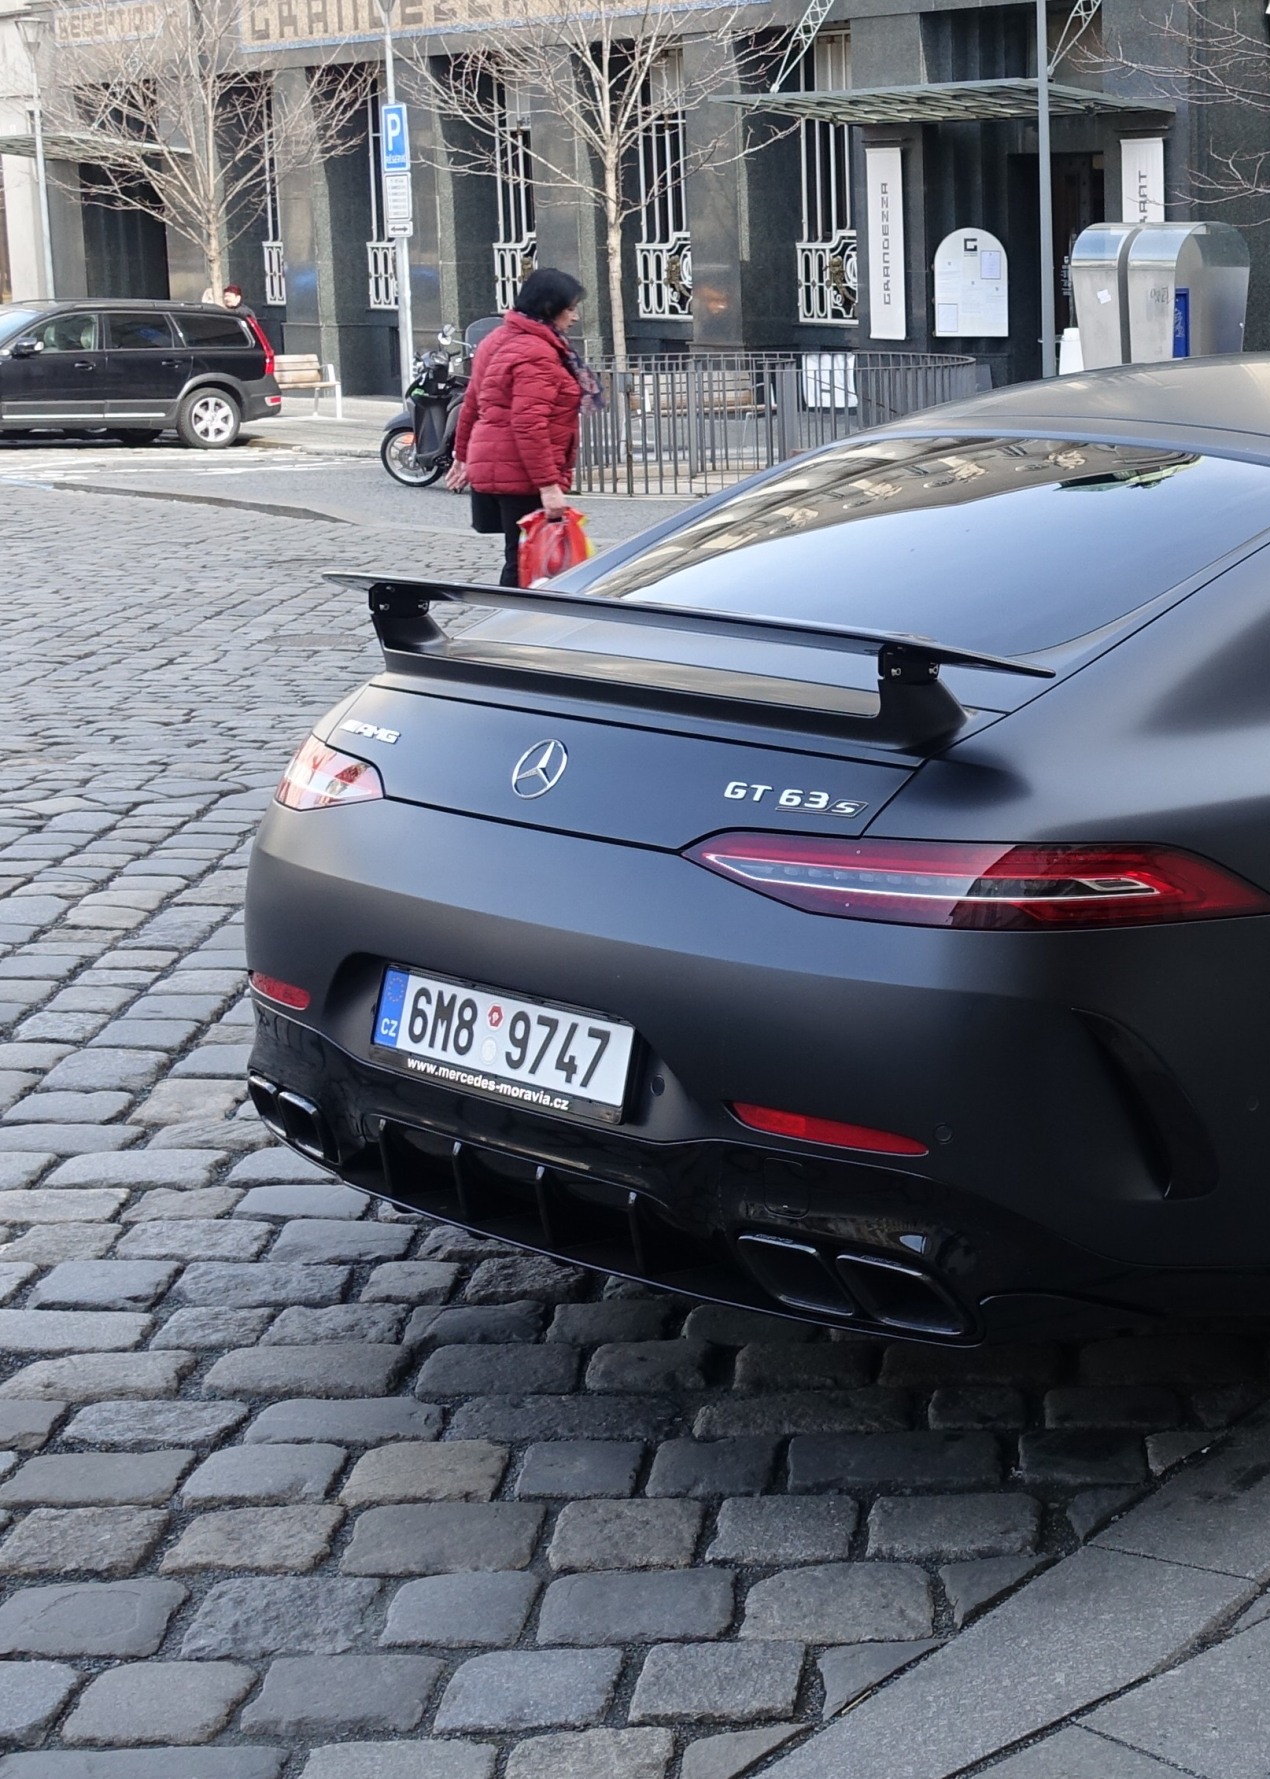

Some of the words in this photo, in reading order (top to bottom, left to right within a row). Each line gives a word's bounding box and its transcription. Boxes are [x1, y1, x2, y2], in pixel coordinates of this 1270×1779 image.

[386, 113, 401, 152] P
[881, 182, 892, 305] GRANDEZZA
[963, 238, 978, 252] G
[350, 721, 401, 745] AMG
[723, 781, 773, 802] GT
[380, 1017, 398, 1038] CZ
[408, 986, 479, 1056] 6M8
[505, 1010, 611, 1088] 9747
[407, 1056, 569, 1111] www.mercedes-moravia.cz
